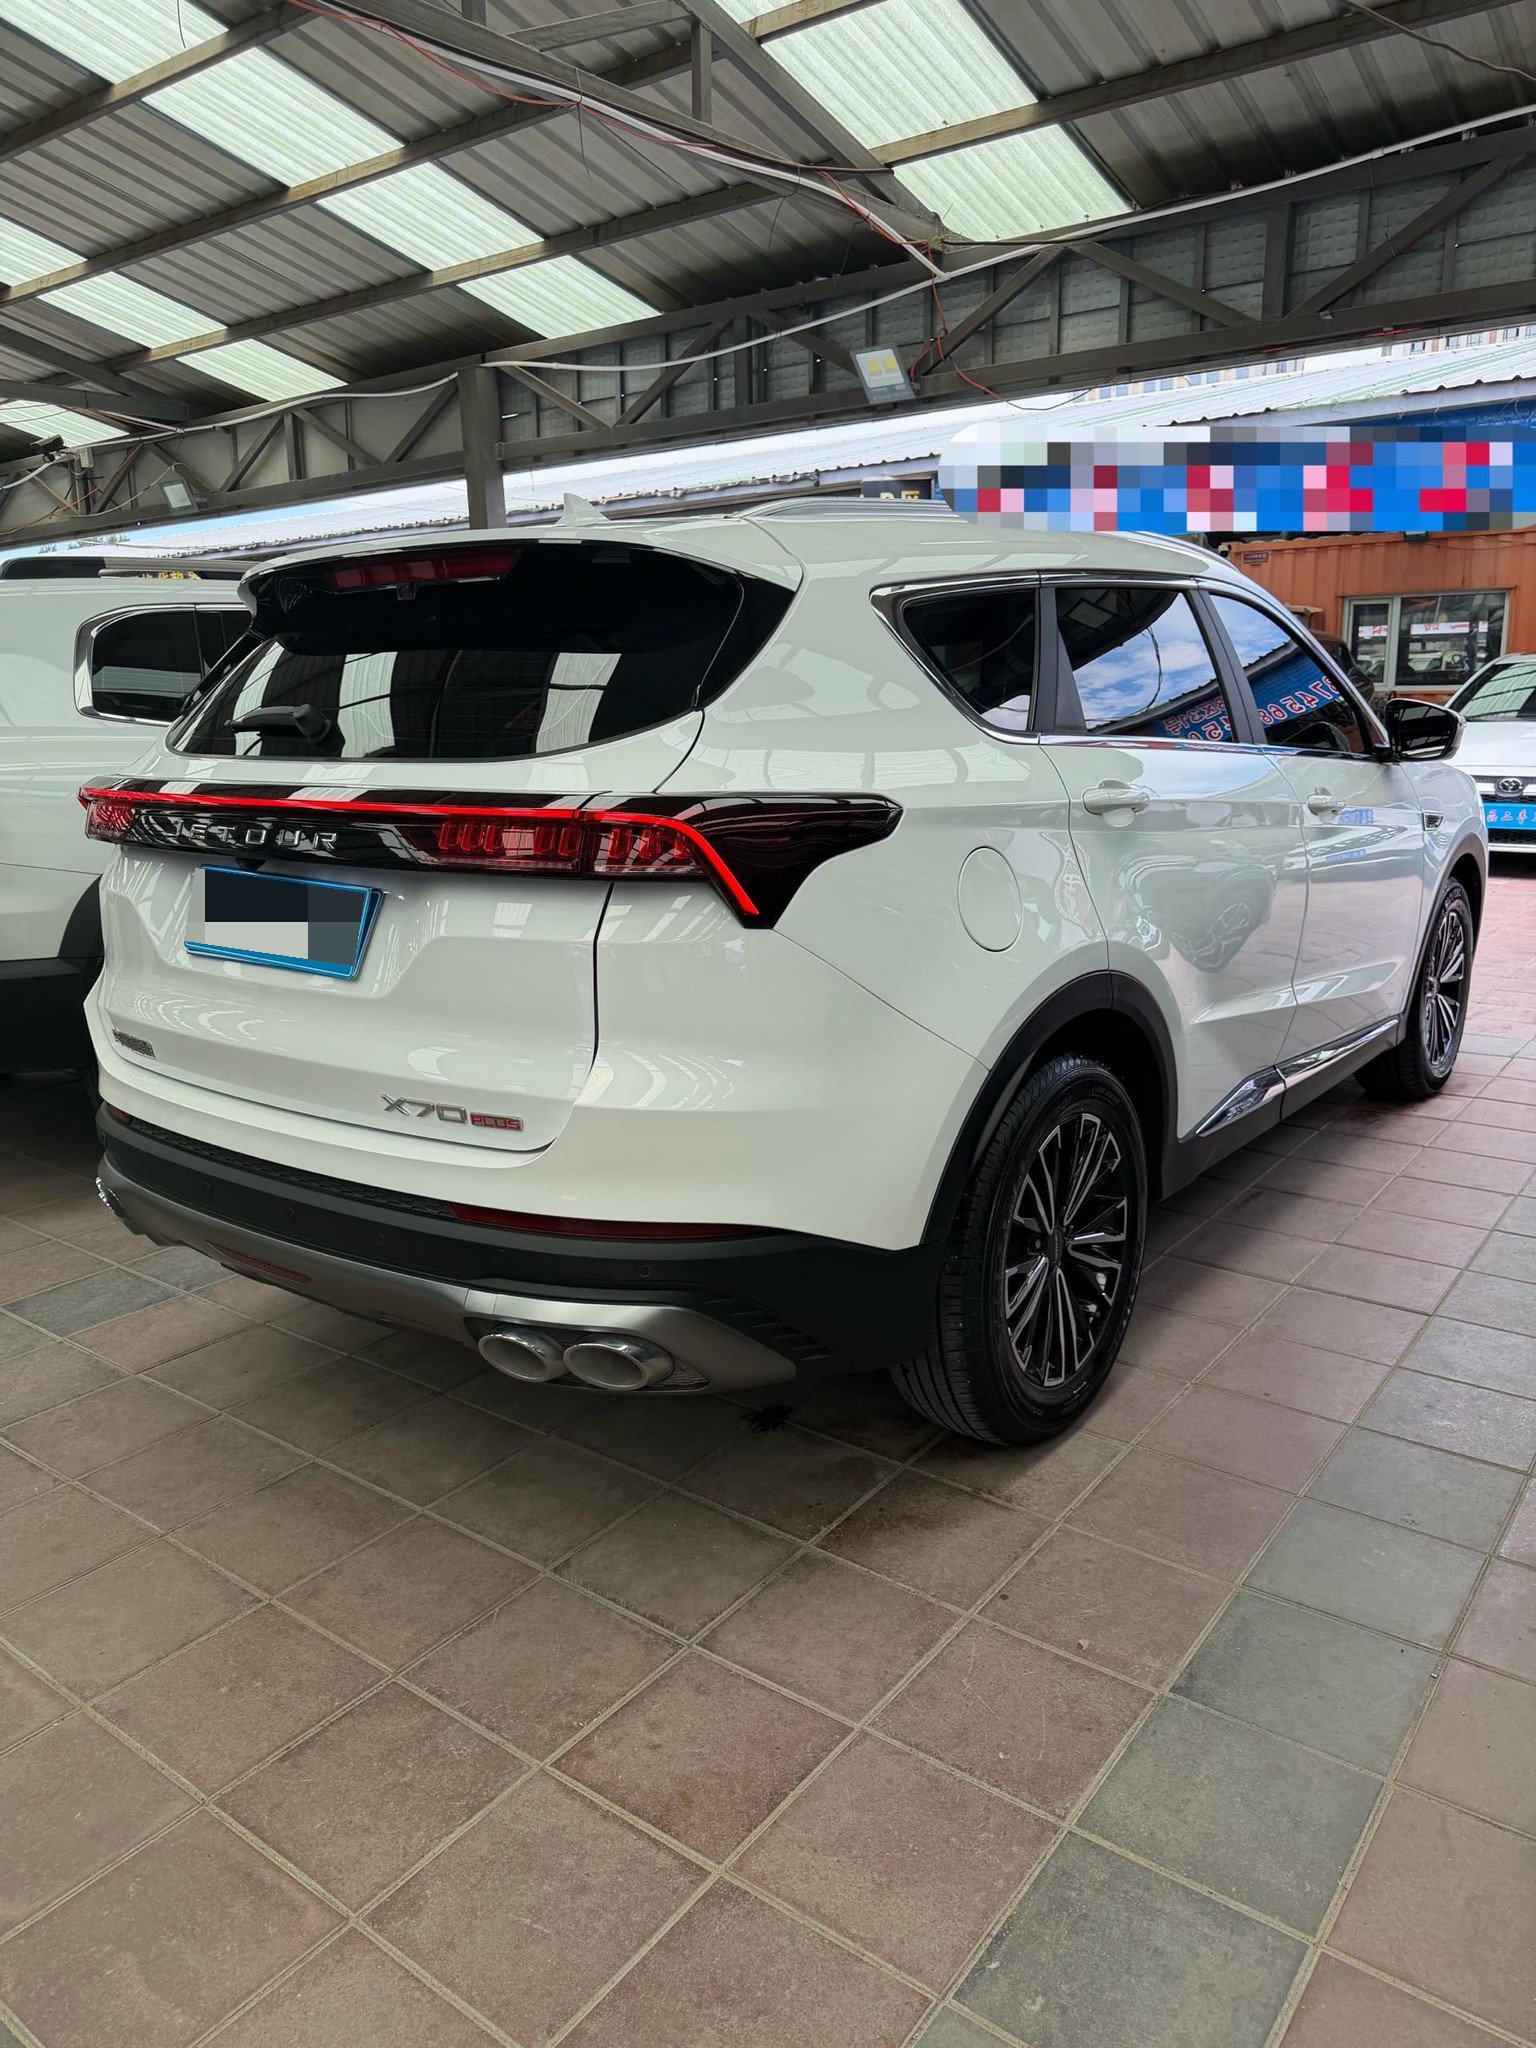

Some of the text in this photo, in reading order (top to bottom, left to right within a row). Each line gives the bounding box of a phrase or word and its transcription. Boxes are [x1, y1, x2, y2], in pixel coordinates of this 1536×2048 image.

[1486, 809, 1536, 824] 品二手
[171, 820, 337, 851] JETOUR
[381, 1093, 522, 1131] X70 PLUS
